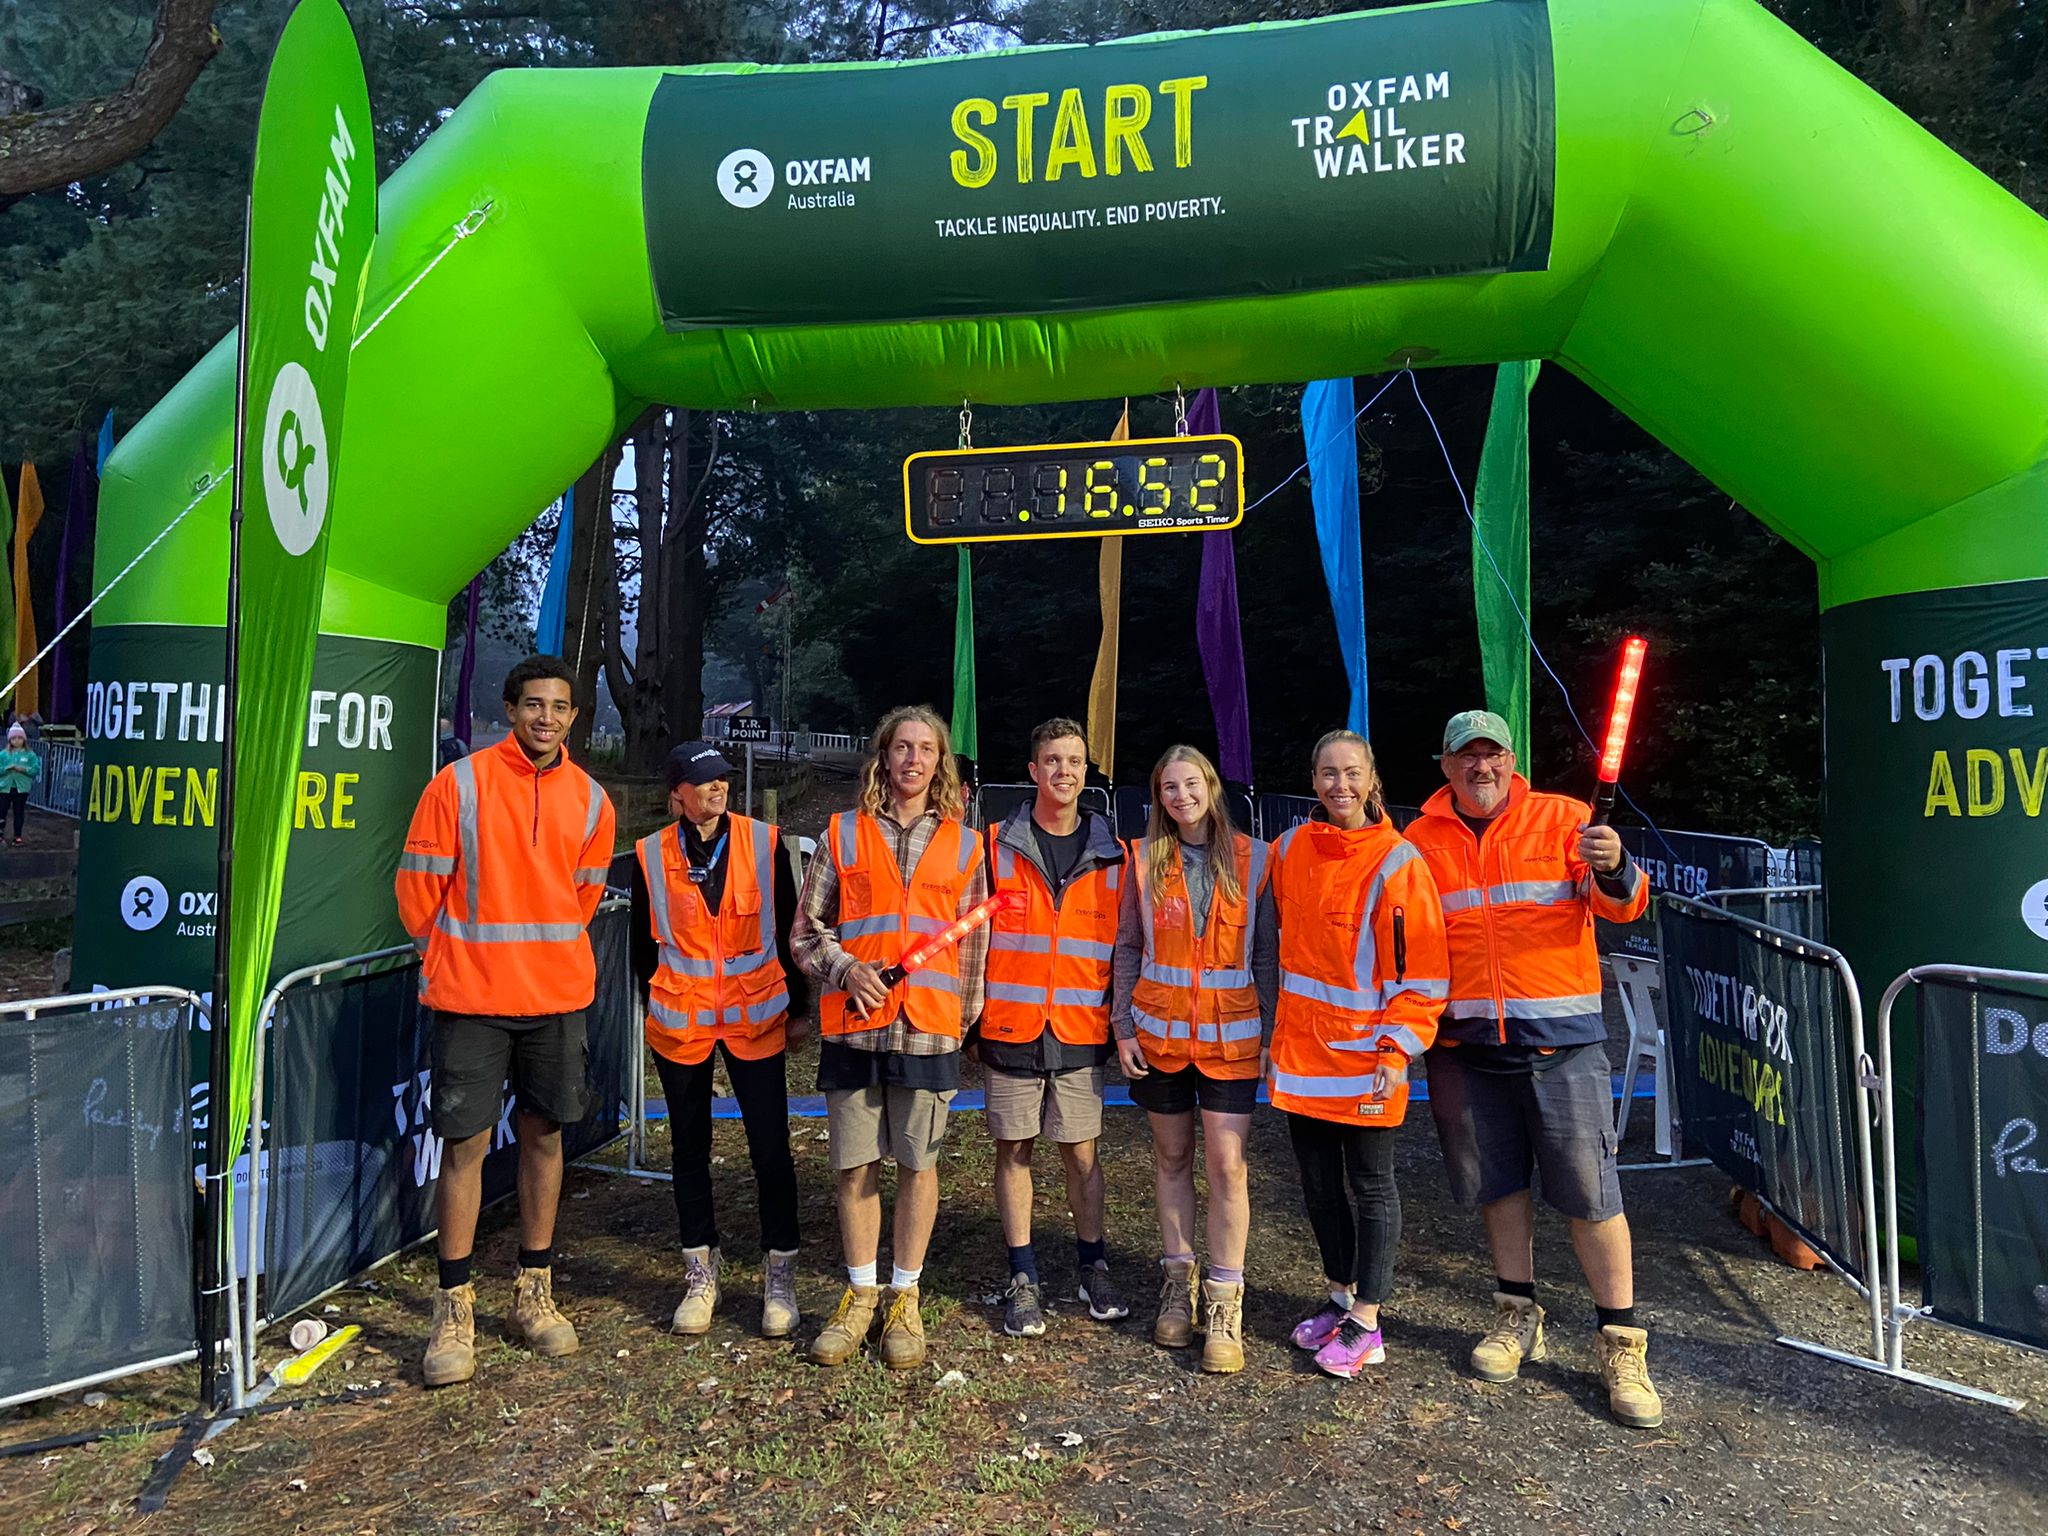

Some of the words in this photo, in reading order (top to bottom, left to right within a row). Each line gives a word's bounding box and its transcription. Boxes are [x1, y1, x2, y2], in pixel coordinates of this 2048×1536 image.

[1328, 71, 1450, 112] OXFAM
[949, 74, 1209, 189] START
[785, 156, 871, 187] OXFAM
[1313, 132, 1467, 179] WALKER
[787, 191, 856, 210] Australia
[935, 216, 998, 238] TACKLE
[1001, 208, 1101, 234] INEQUALITY.
[1105, 205, 1140, 226] END
[1144, 196, 1226, 222] POVERTY.
[304, 103, 356, 352] OXFAM
[1138, 518, 1174, 528] SEIKO
[1176, 516, 1204, 527] Sports
[1205, 515, 1230, 525] Timer
[308, 690, 393, 751] FOR
[732, 728, 767, 739] POINT
[738, 719, 761, 729] T.R.
[1673, 863, 1708, 895] FOR
